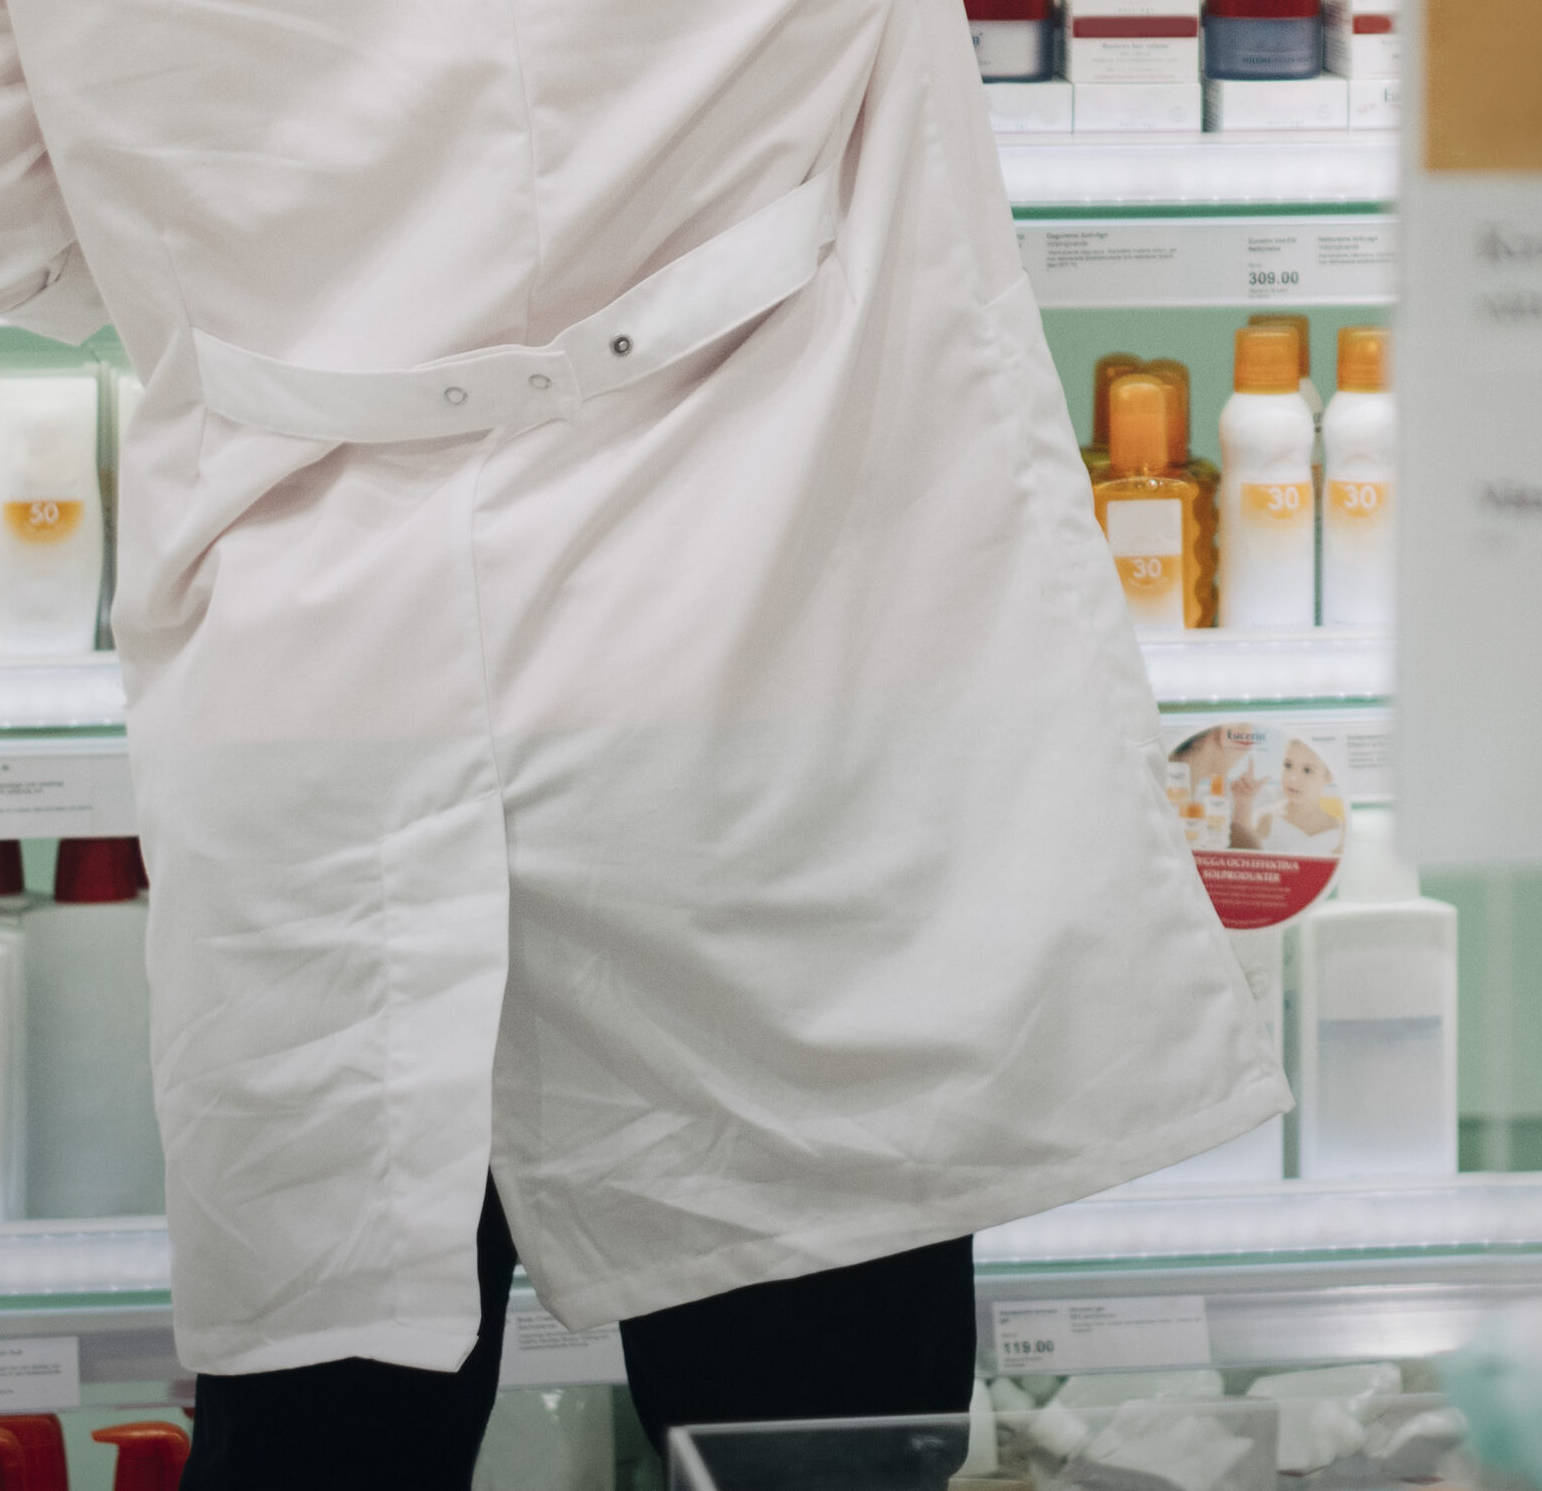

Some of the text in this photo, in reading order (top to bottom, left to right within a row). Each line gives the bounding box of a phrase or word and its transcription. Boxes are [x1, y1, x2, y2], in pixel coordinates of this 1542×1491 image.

[1248, 271, 1300, 285] 309.00
[1267, 486, 1300, 512] 30
[1343, 485, 1378, 510] 30
[29, 501, 59, 524] 50
[1131, 558, 1162, 579] 30
[1226, 729, 1266, 741] Eucerin
[1003, 1340, 1055, 1355] 119.00
